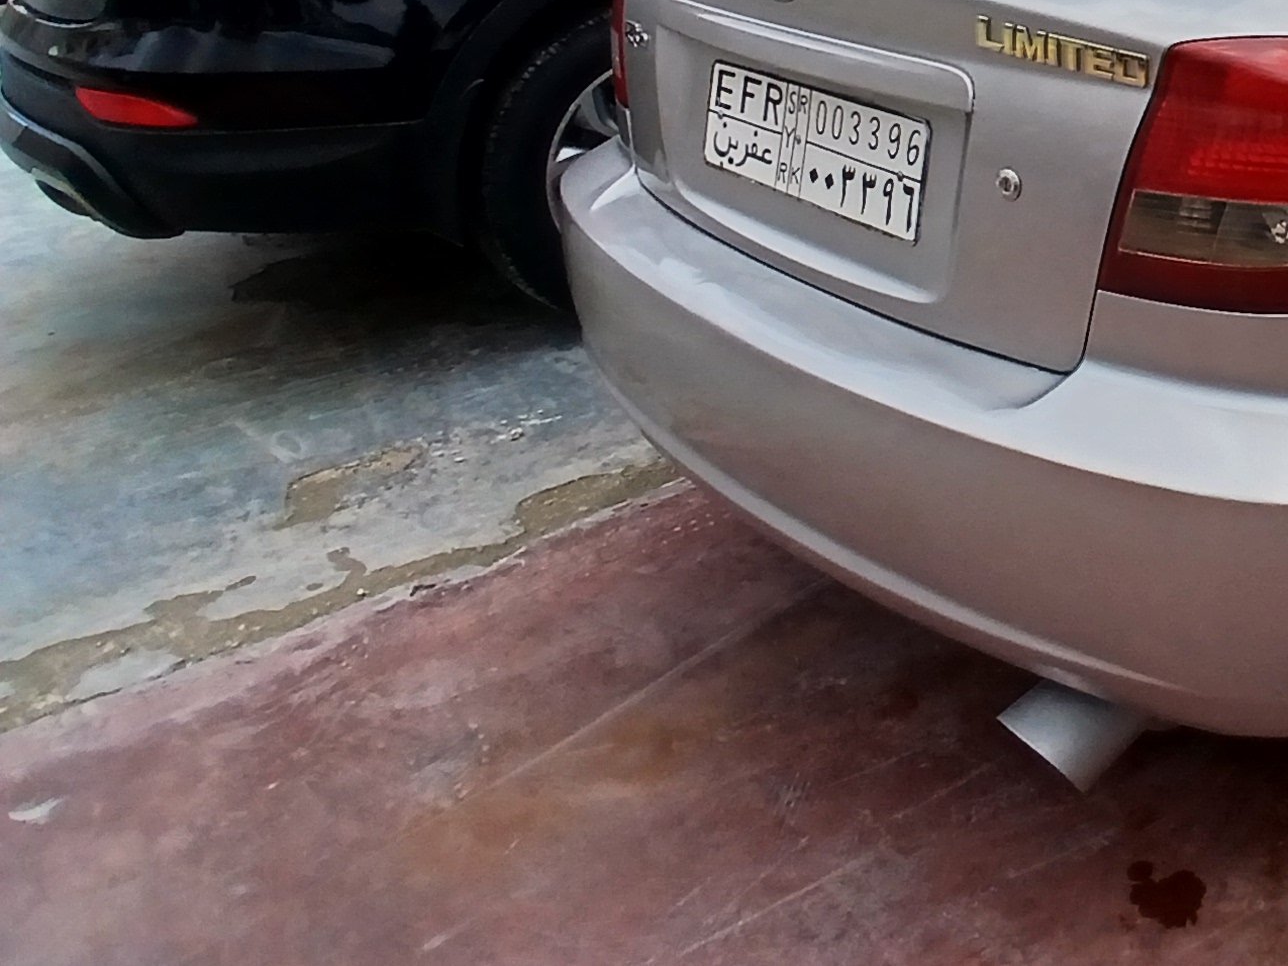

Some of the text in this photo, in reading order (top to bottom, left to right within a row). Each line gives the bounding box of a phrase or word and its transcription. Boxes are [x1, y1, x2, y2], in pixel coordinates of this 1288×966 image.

[976, 13, 1150, 89] LIMITED
[714, 69, 784, 126] EFR
[713, 121, 774, 167] عفرين
[814, 100, 922, 167] 003396
[808, 164, 916, 233] ٠٠٣٣٩٦
